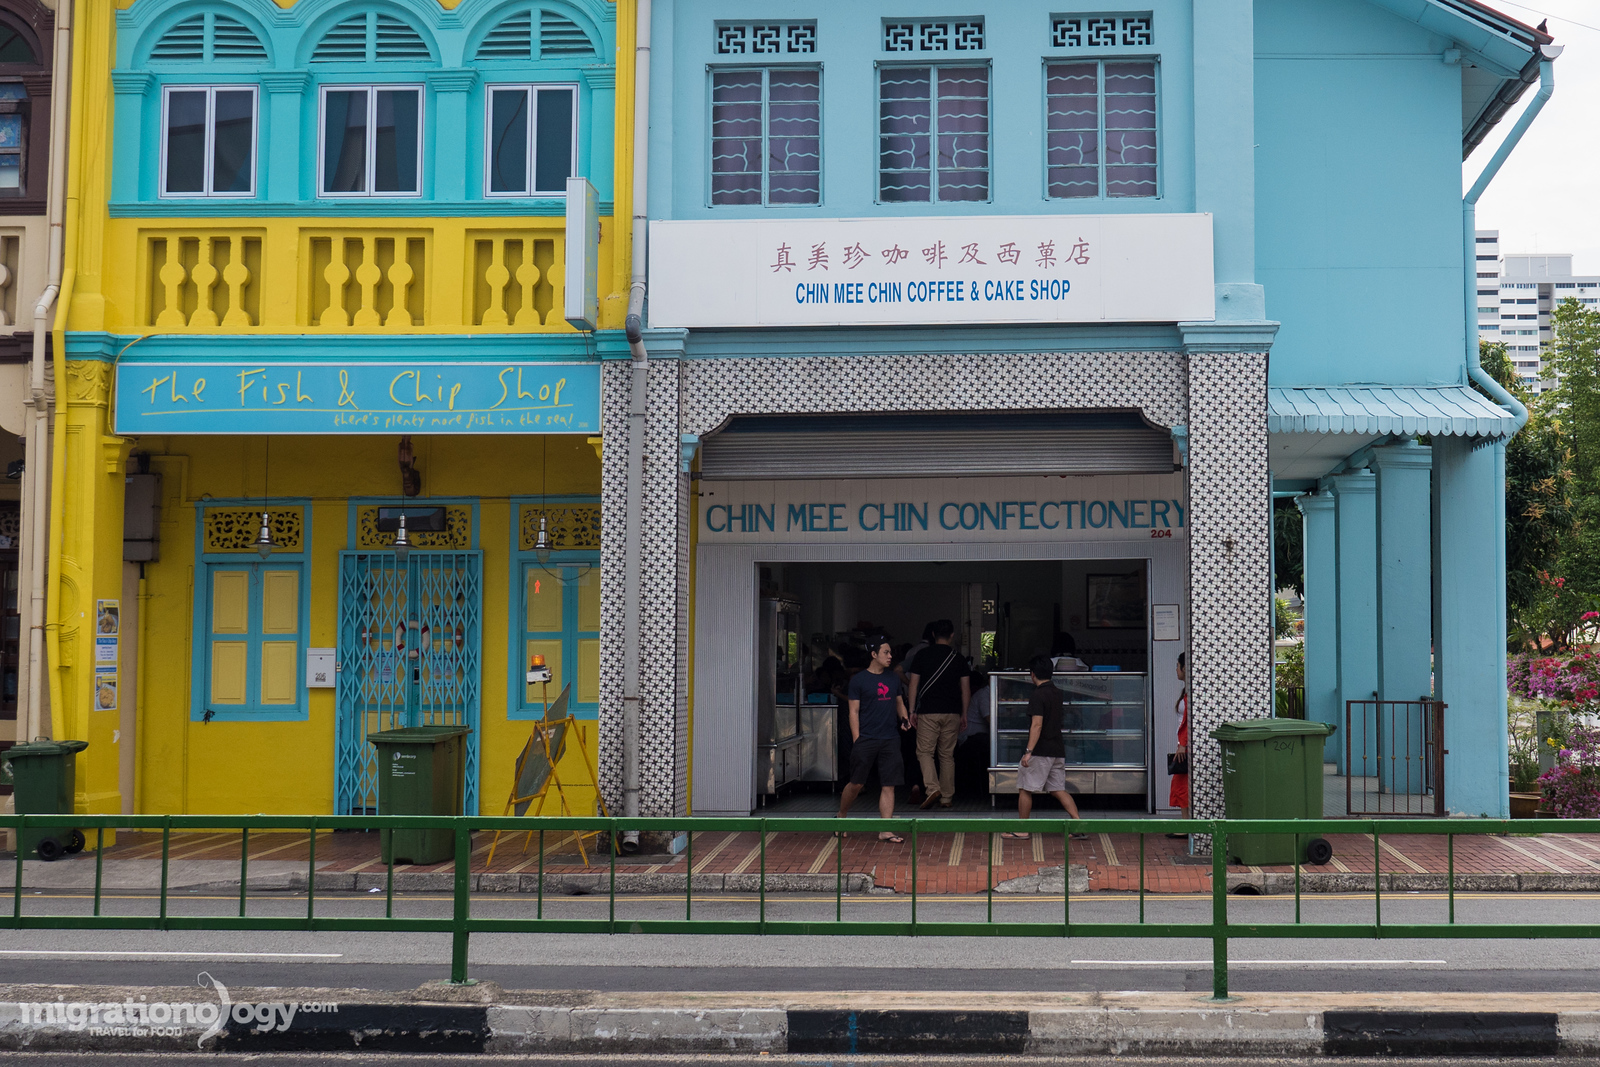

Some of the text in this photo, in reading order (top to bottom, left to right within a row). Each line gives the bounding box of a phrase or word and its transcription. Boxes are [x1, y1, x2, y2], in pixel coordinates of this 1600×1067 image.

[770, 237, 1091, 273] 真美珍咖啡及西菓店
[796, 279, 1071, 303] CHIN MEE CHIN COFFEE & CAKE SHOP
[236, 368, 313, 407] Fish
[338, 369, 359, 410] &
[389, 369, 461, 411] Chip
[489, 367, 566, 410] Shop
[334, 412, 573, 429] there's plenty more fish in the sea!
[706, 499, 1184, 533] CHIN MEE CHIN CONFECTIONERY
[1150, 529, 1172, 539] 204
[1273, 741, 1295, 755] 204
